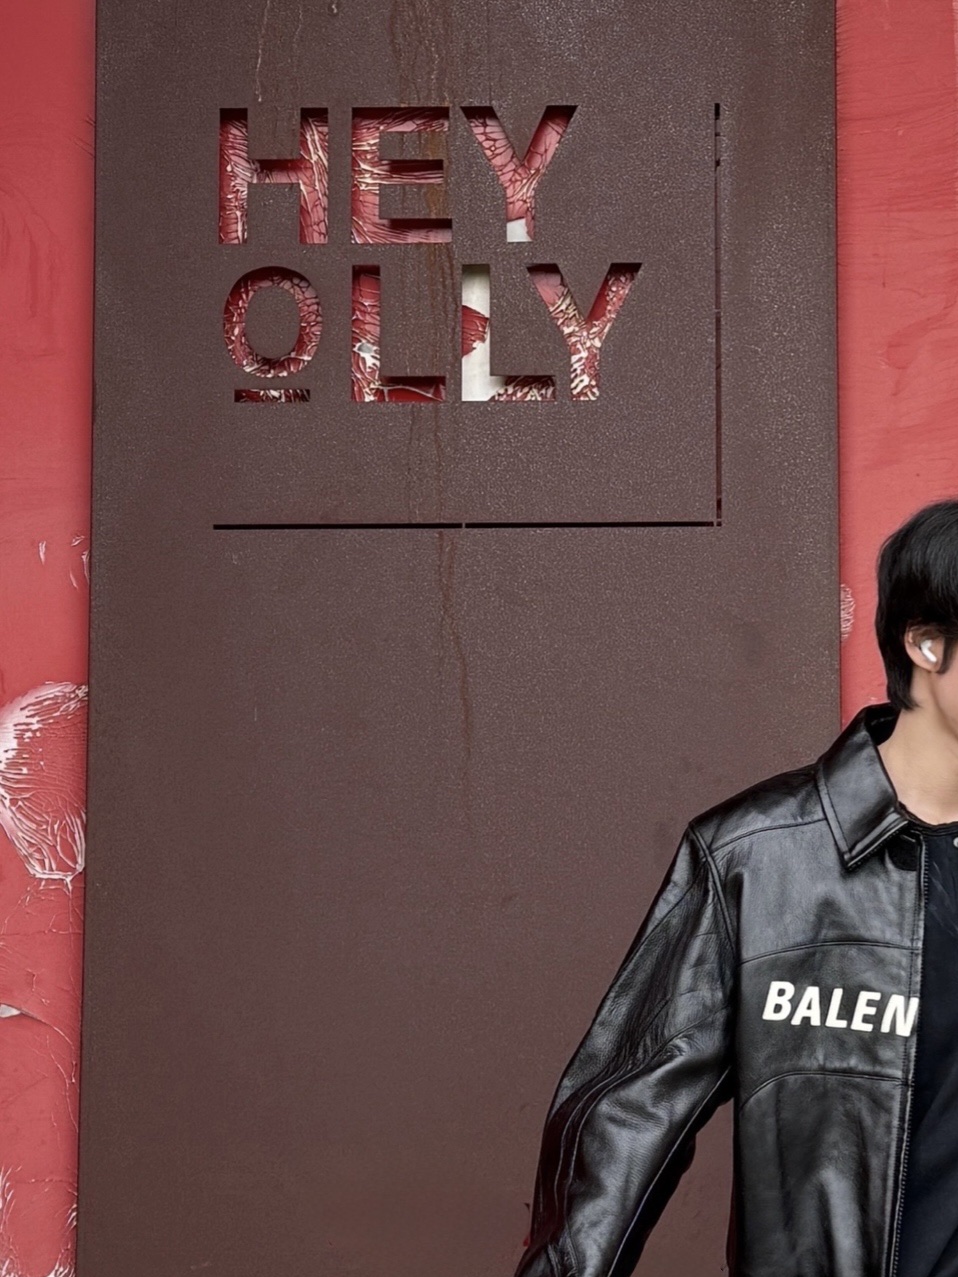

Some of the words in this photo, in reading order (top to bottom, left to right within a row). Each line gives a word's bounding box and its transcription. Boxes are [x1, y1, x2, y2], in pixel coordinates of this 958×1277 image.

[219, 105, 578, 244] HEY
[223, 262, 643, 402] OLLY
[762, 980, 920, 1037] BALEN
